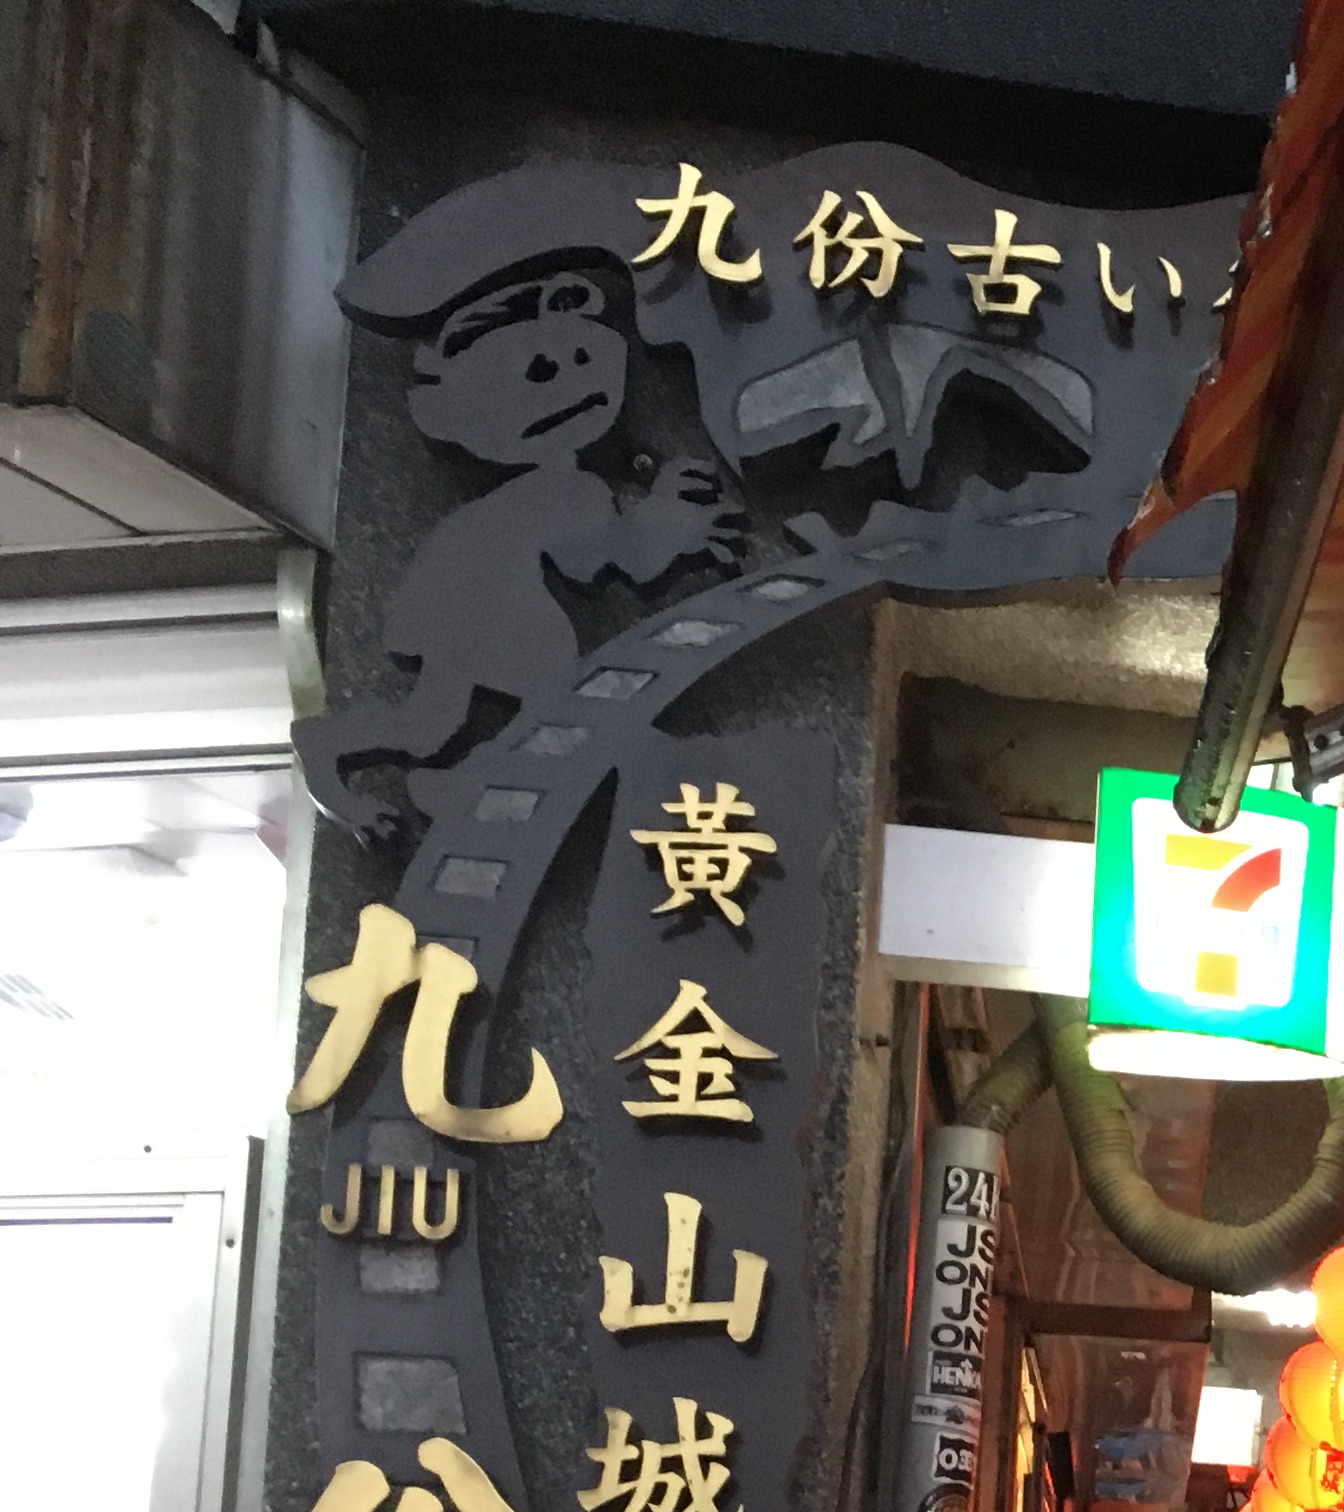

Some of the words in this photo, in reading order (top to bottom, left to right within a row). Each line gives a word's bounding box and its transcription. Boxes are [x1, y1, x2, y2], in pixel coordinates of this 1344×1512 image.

[633, 163, 1241, 316] 九份古い
[320, 1163, 460, 1241] JIU
